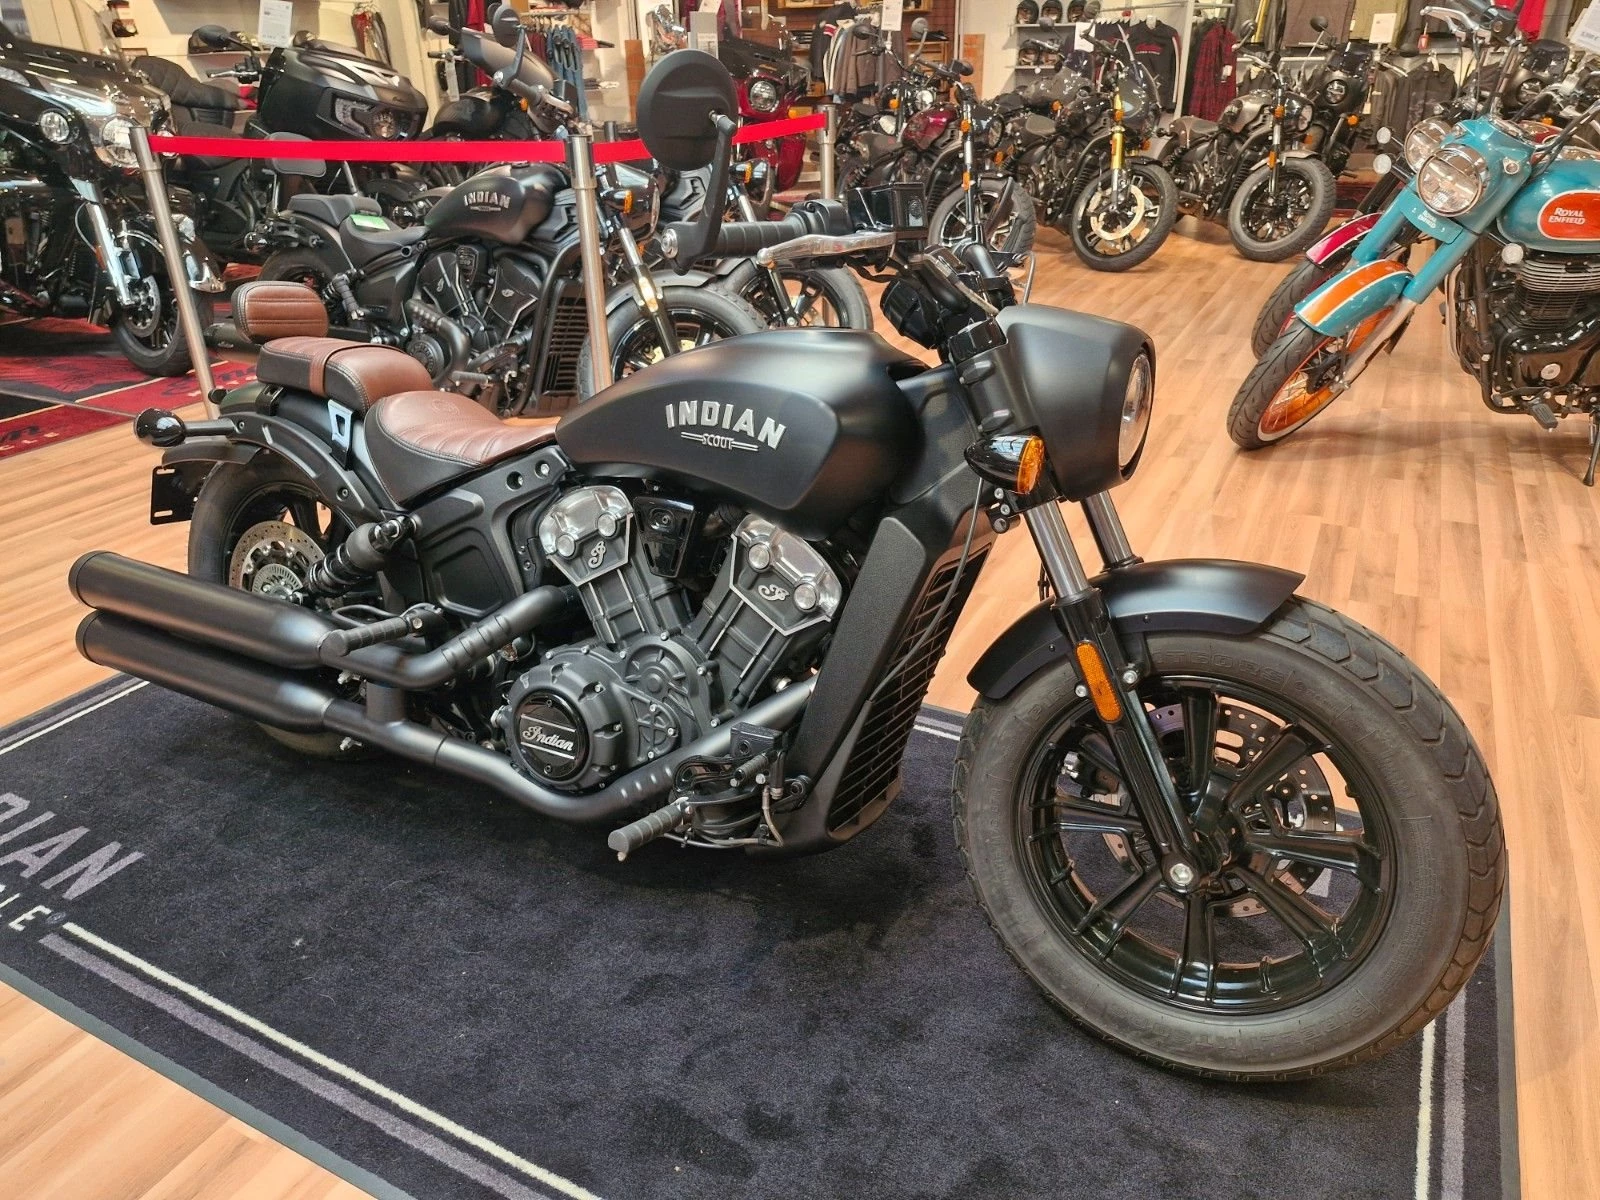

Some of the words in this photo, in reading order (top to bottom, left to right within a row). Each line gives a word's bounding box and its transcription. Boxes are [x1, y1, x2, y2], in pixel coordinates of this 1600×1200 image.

[463, 191, 511, 209] INDIAN
[1548, 215, 1586, 225] ENFIELD
[1553, 207, 1584, 217] ROYAL
[665, 400, 786, 450] INDIAN
[701, 433, 734, 450] SCOUT
[522, 726, 574, 751] Indian
